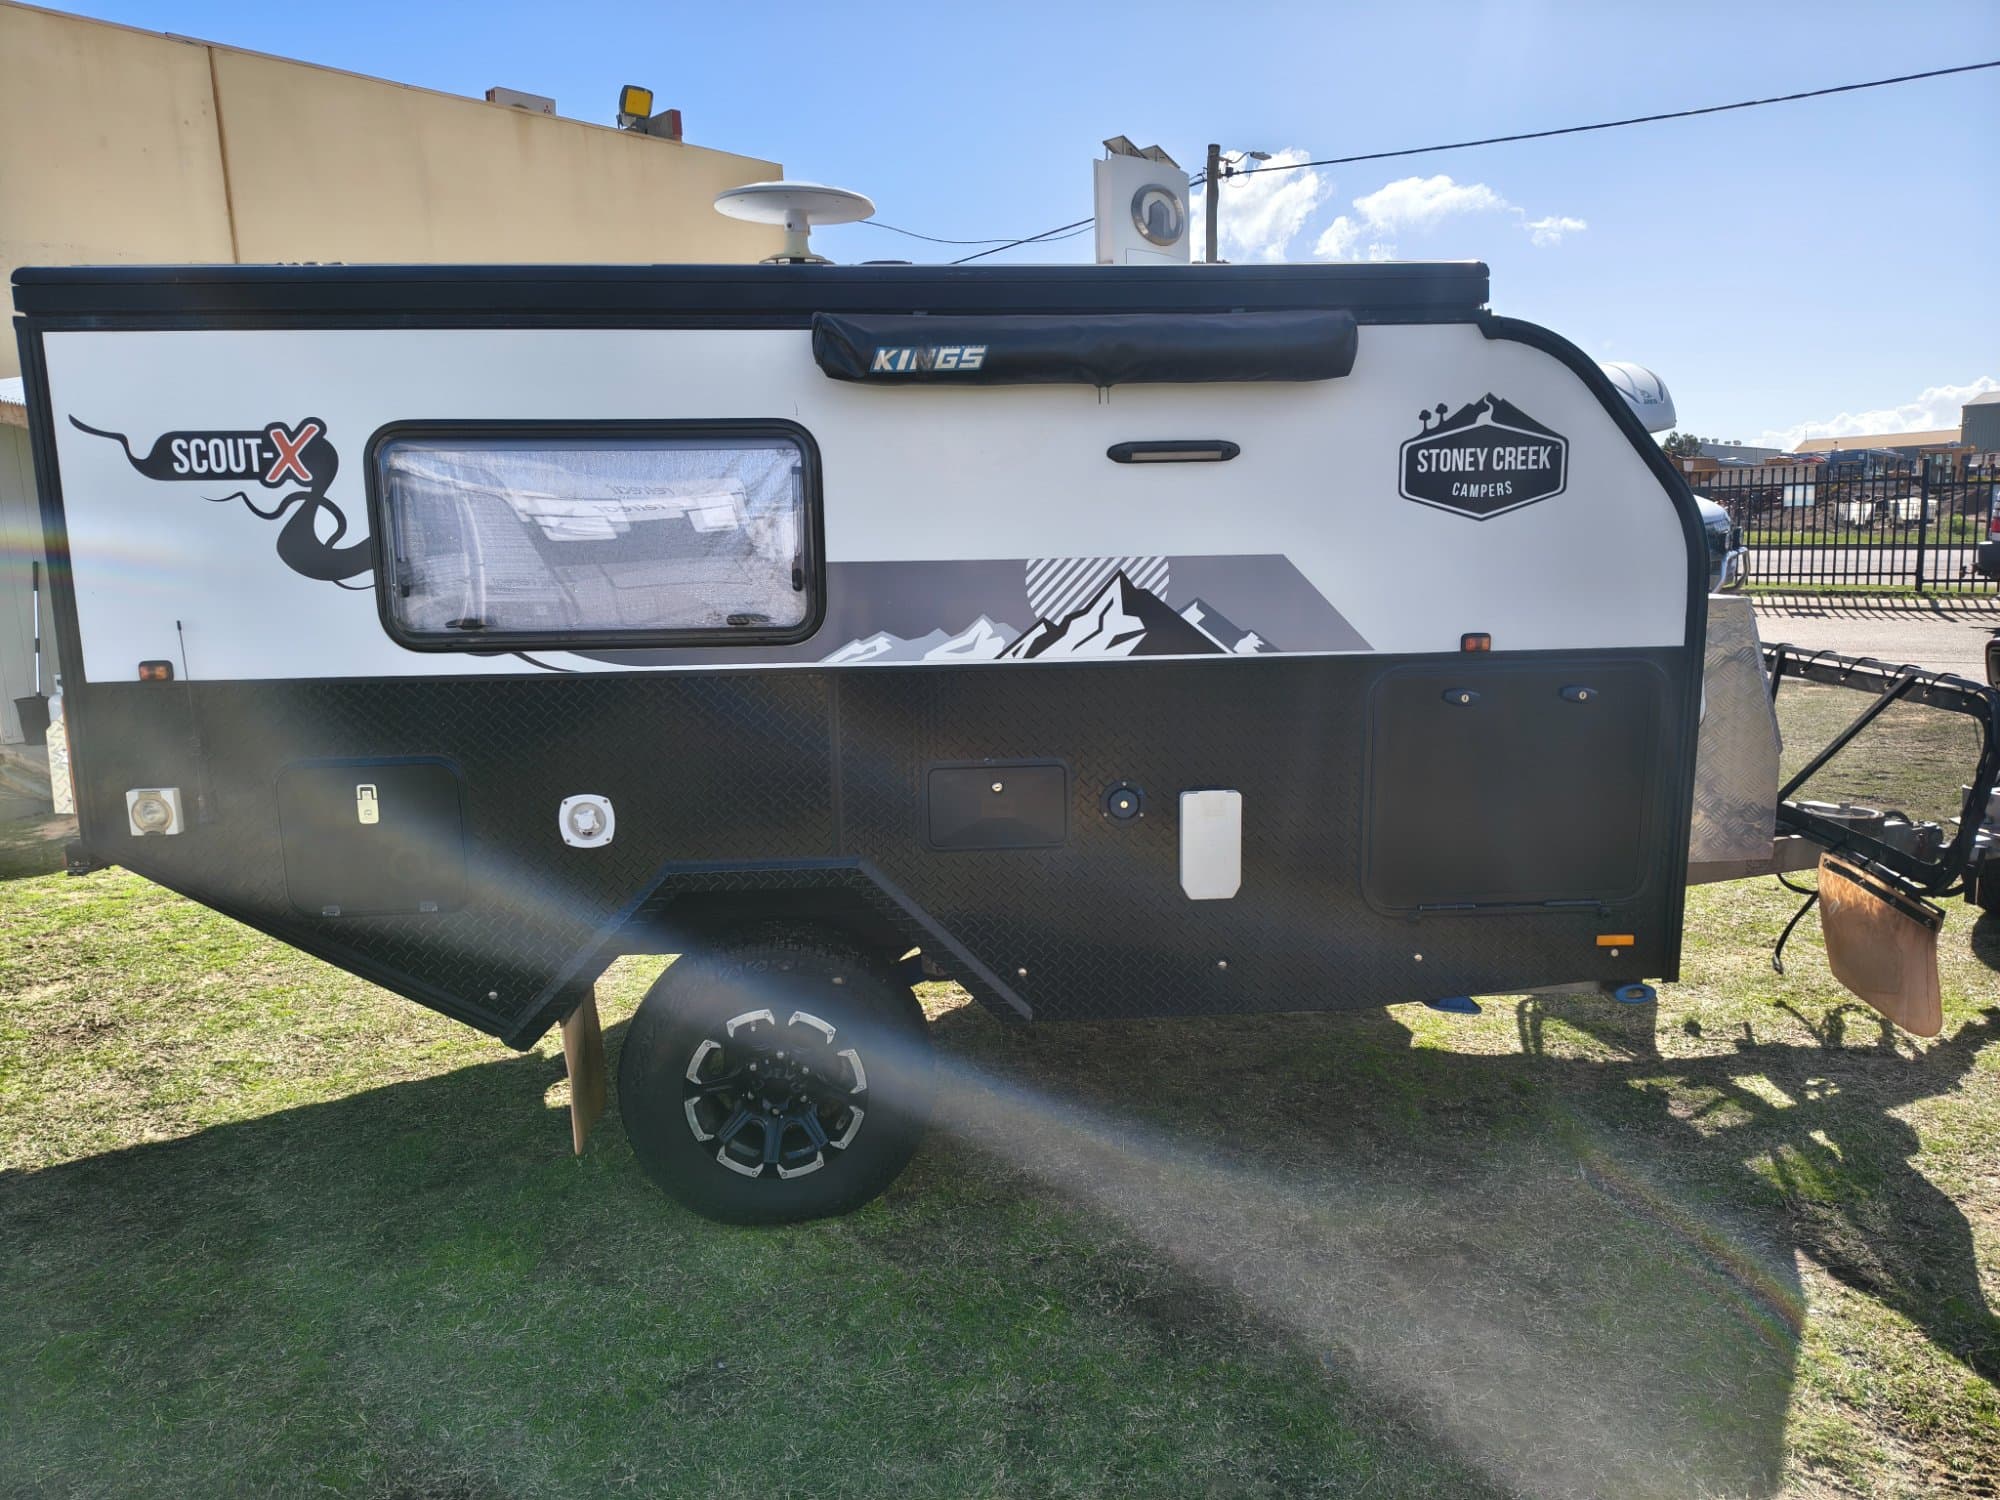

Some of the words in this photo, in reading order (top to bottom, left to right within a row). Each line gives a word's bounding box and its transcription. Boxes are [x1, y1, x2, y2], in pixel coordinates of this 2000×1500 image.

[873, 346, 986, 371] KINGS
[171, 423, 320, 483] SCOUT-X
[1417, 447, 1489, 473] STONEY
[1492, 445, 1553, 471] CREEK
[1451, 480, 1513, 498] CAMPERS
